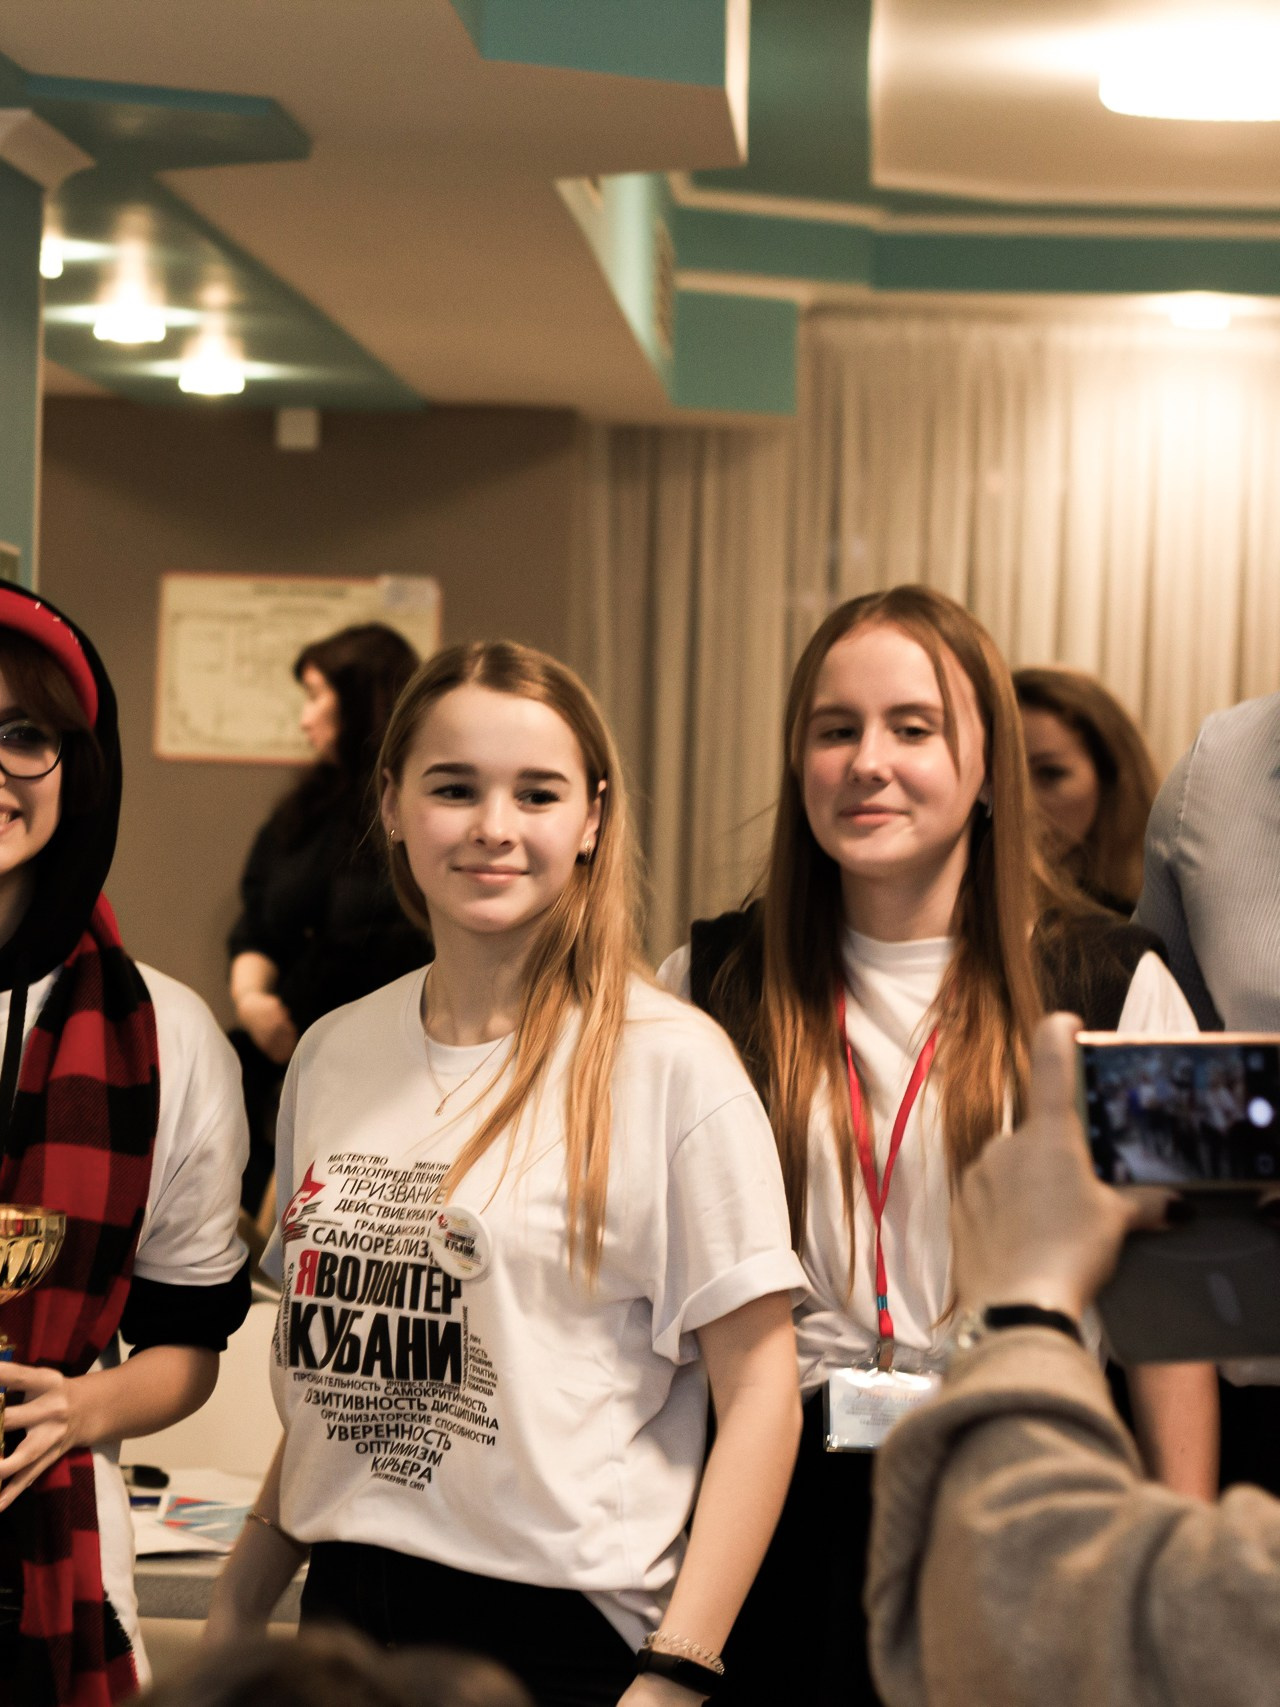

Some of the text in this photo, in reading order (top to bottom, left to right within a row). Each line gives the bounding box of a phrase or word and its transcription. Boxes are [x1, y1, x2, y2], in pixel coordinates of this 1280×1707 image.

[327, 1153, 388, 1166] МАСТЕРСТВО
[328, 1163, 444, 1186] САМООПРЕДЕЛЕНИ
[334, 1199, 404, 1222] ДЕЙСТВИЕ
[289, 1301, 462, 1384] КУБАНИ
[305, 1388, 499, 1430] ОЗИТИВНОСТЬ ДИСЦИПЛИНА
[321, 1409, 496, 1446] ОРГАНИЗАТОРСКИЕ СПОСОБНОСТИ
[326, 1423, 451, 1451] УВЕРЕННОСТЬ
[355, 1441, 443, 1467] ОПТИМИЗМ
